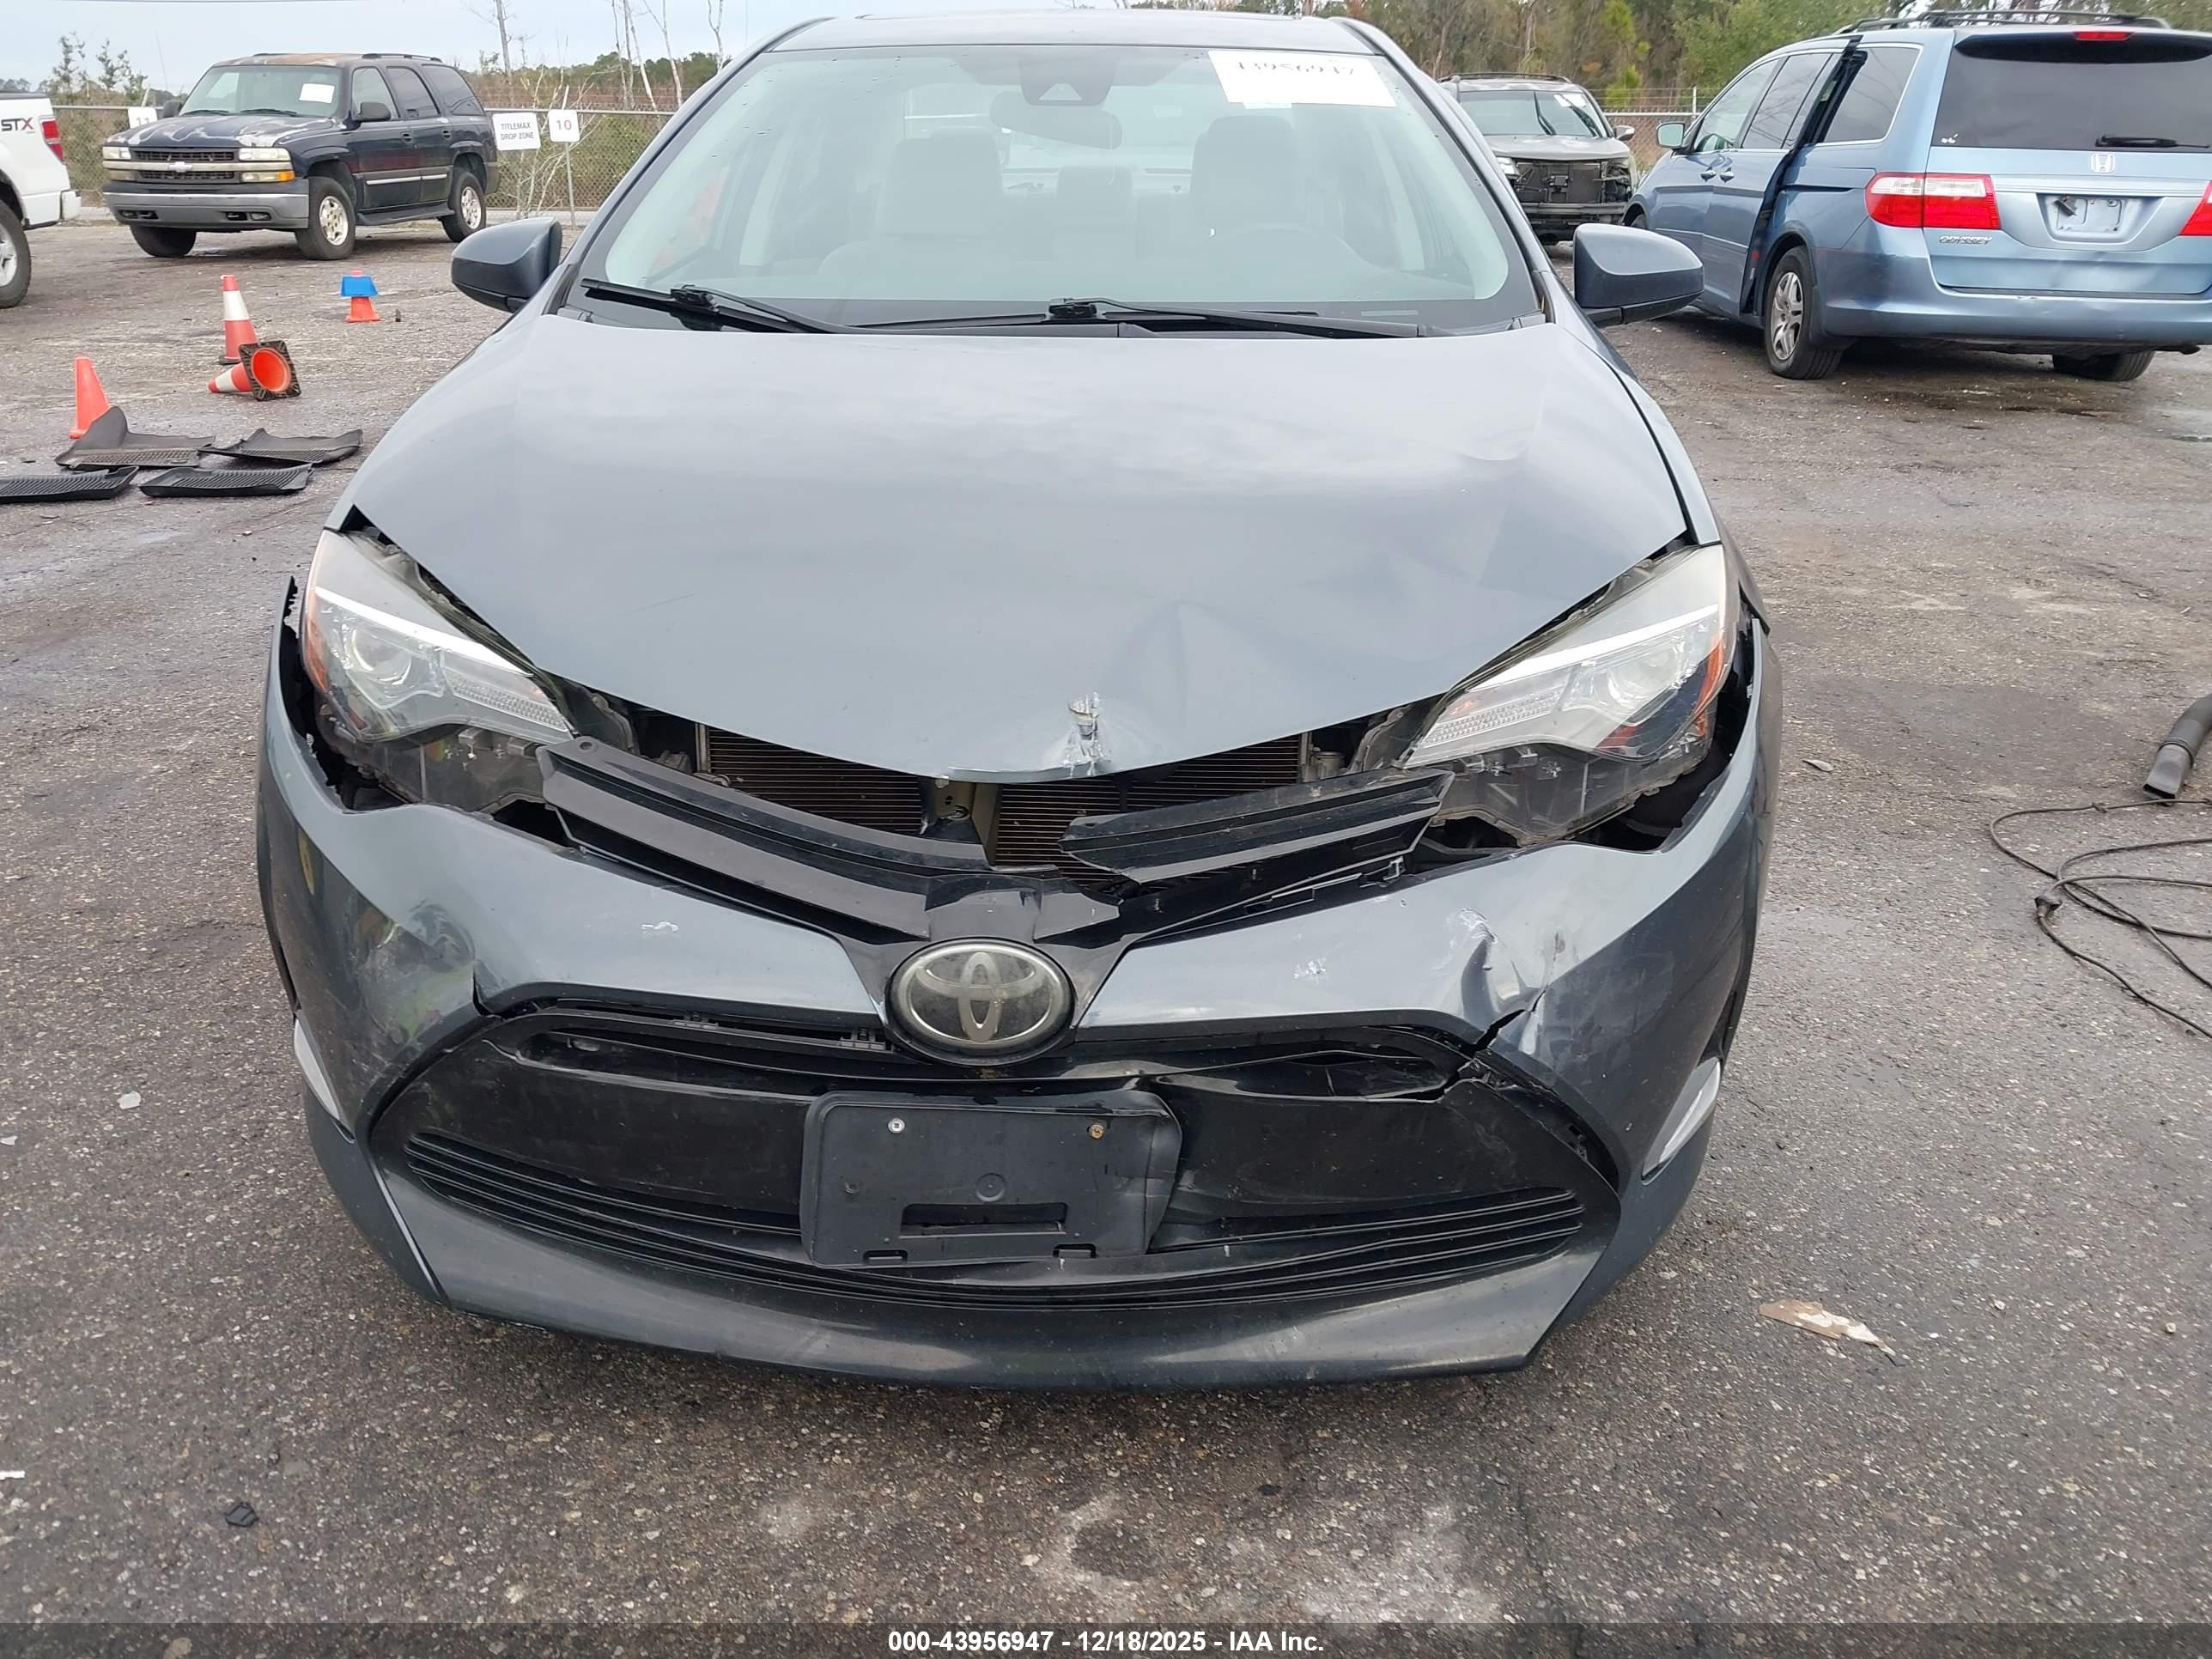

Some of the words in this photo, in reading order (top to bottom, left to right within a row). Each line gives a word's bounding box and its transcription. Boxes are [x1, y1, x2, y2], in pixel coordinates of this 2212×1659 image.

[1, 117, 34, 131] STX
[501, 122, 531, 131] TITLEMAX
[556, 119, 572, 131] 10
[501, 132, 518, 141] DROP
[519, 131, 535, 140] ZONE
